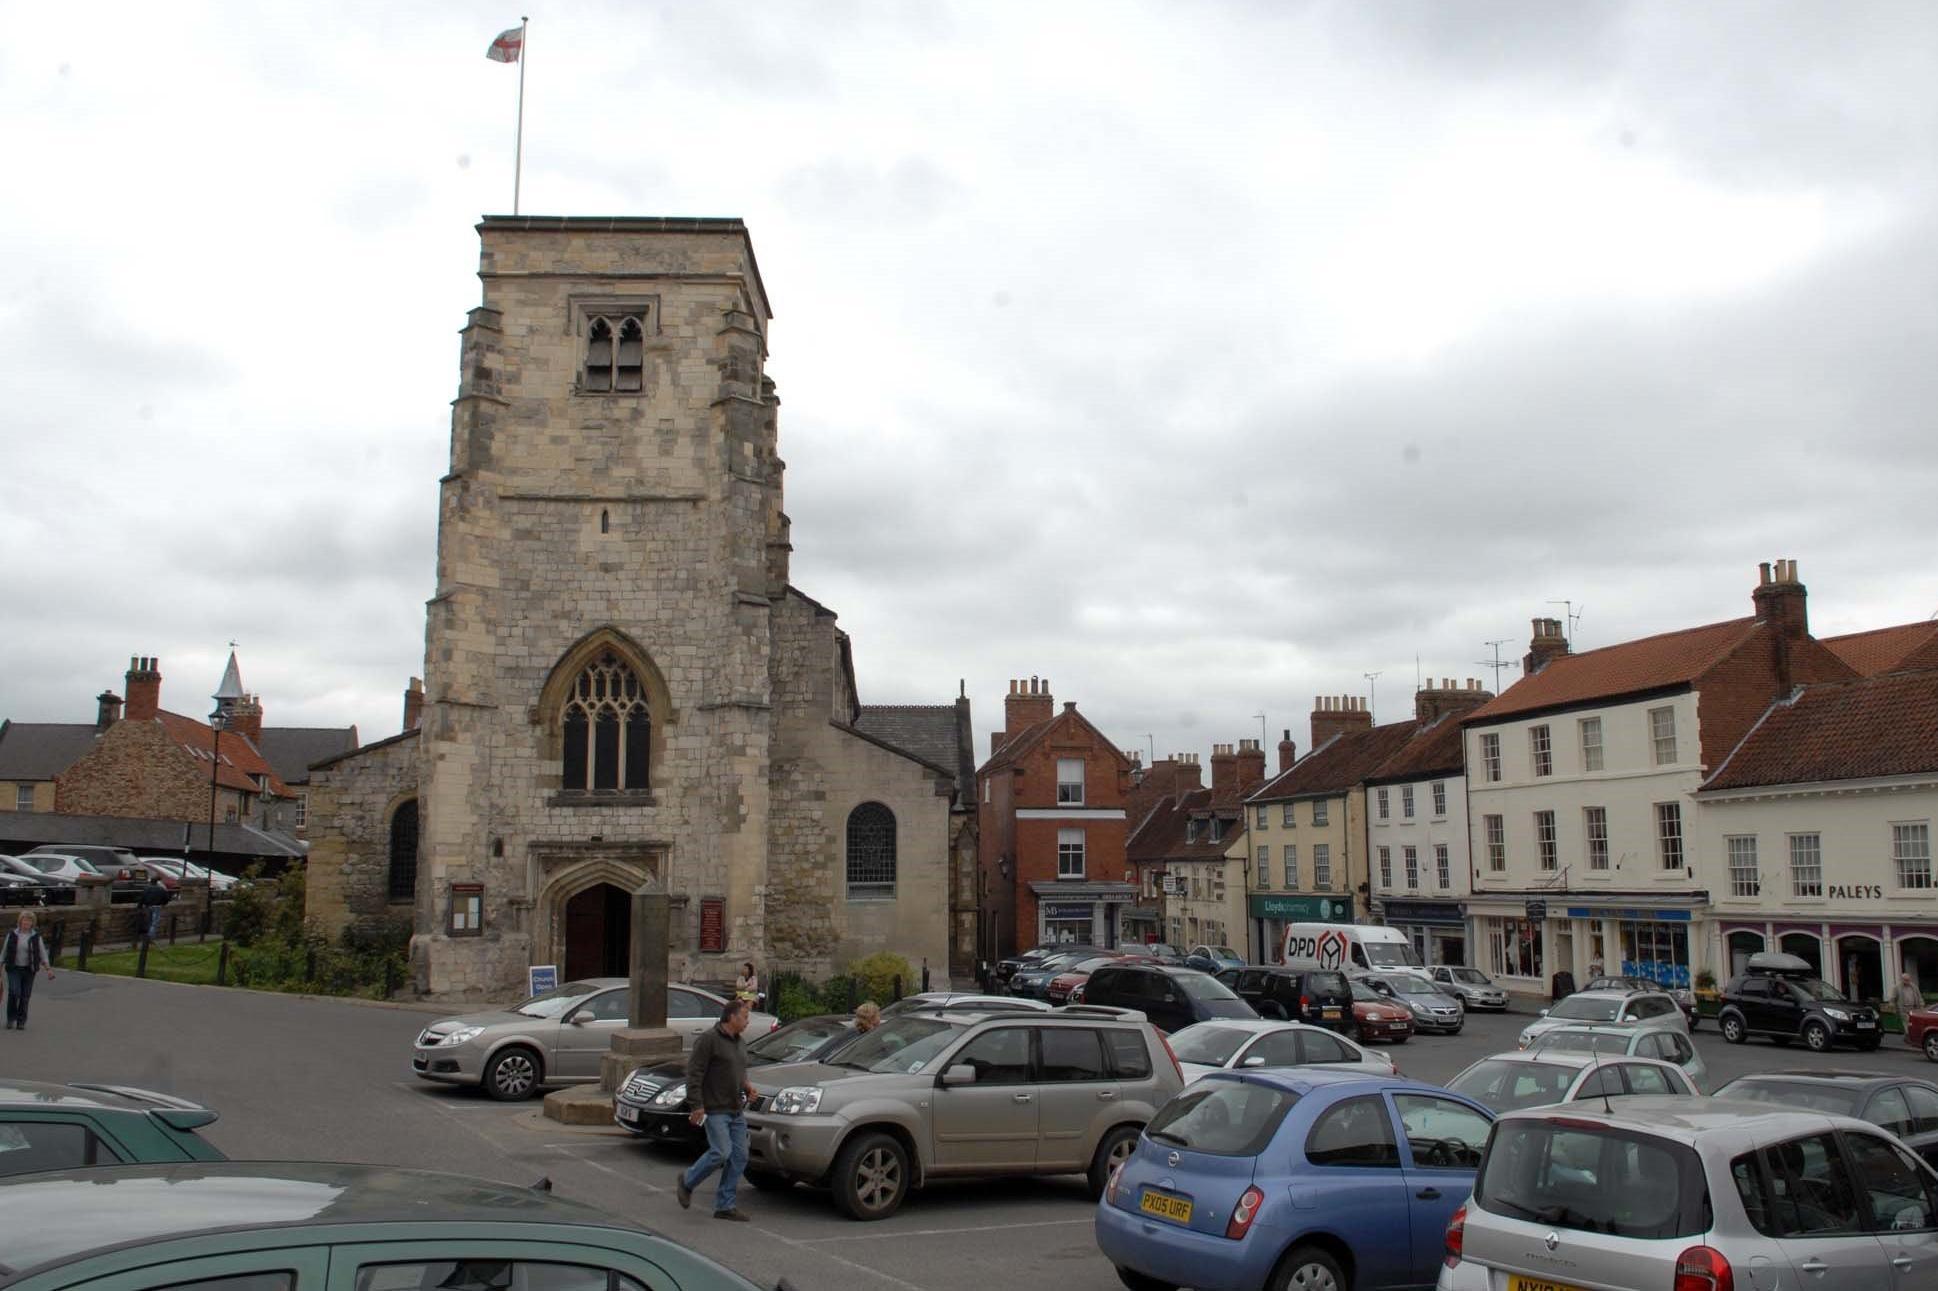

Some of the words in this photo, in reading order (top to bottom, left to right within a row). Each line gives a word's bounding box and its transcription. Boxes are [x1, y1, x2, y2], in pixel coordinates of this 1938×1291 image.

[1828, 885, 1882, 899] PALEYS
[1288, 936, 1316, 958] DPD
[1143, 1193, 1168, 1212] PX05
[1169, 1199, 1190, 1218] URF
